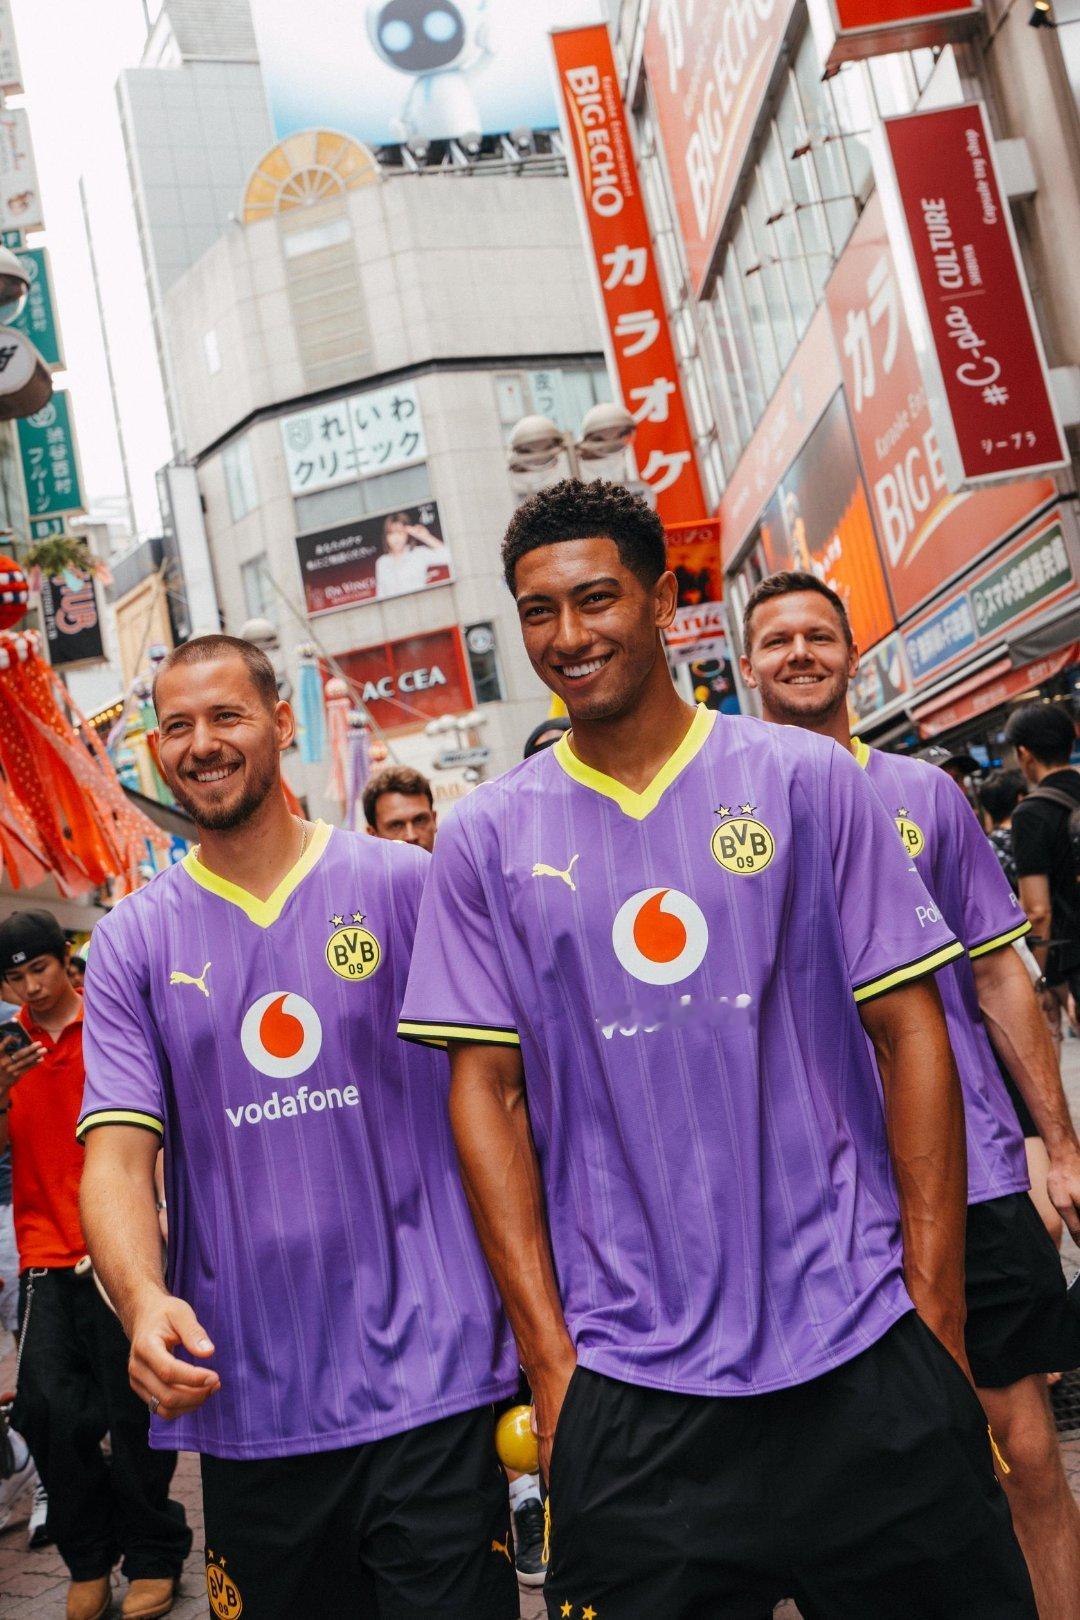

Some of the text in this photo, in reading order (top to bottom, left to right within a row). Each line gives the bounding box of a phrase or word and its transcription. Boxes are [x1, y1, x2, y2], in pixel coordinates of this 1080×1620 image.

[565, 64, 624, 218] BIG ECHO
[921, 198, 964, 289] CULTURE
[602, 244, 692, 494] カラオケ
[320, 396, 416, 441] れいわ
[295, 431, 419, 485] クリニック
[874, 446, 931, 568] BIG
[719, 823, 768, 859] BVB
[736, 855, 755, 869] 09
[333, 932, 375, 967] BVB
[348, 962, 364, 976] 09
[224, 1084, 360, 1128] vodafone
[209, 1568, 238, 1608] BVB
